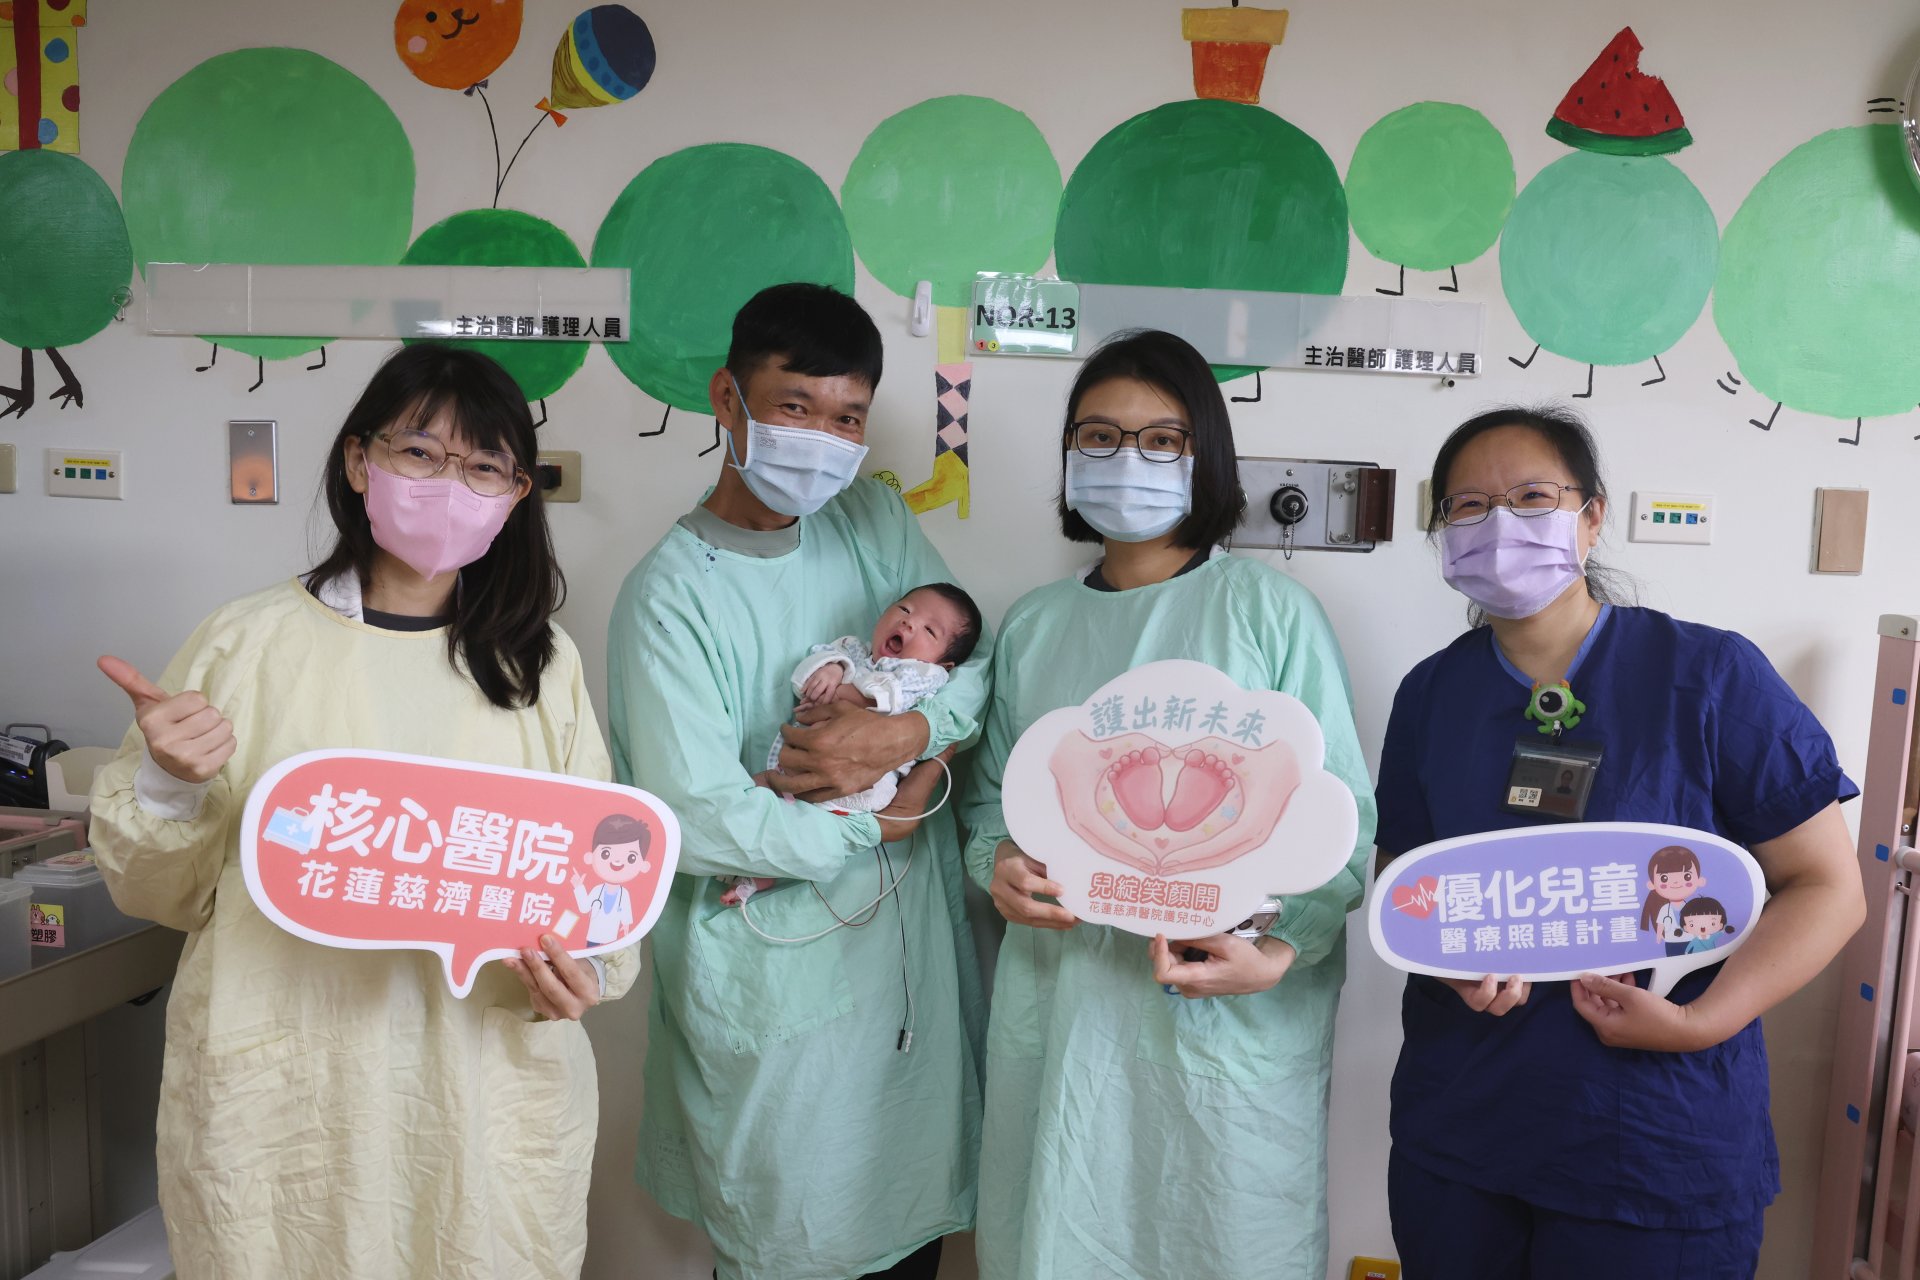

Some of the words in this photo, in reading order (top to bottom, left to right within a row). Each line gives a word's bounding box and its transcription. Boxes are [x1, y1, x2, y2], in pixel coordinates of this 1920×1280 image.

[456, 315, 534, 337] 主治醫師
[542, 315, 621, 338] 護理人員
[976, 304, 1076, 330] NOR-13
[1304, 345, 1387, 370] 主治醫師
[1394, 348, 1476, 374] 護理人員
[1090, 694, 1266, 747] 護出新未來
[302, 783, 574, 885] 核心醫院
[297, 859, 555, 927] 花蓮慈濟醫院
[1434, 862, 1641, 924] 優化兒童
[1089, 901, 1215, 928] 花蓮慈濟醫院護兒中心
[31, 928, 57, 943] 塑膠
[1440, 915, 1638, 954] 醫療照護計畫
